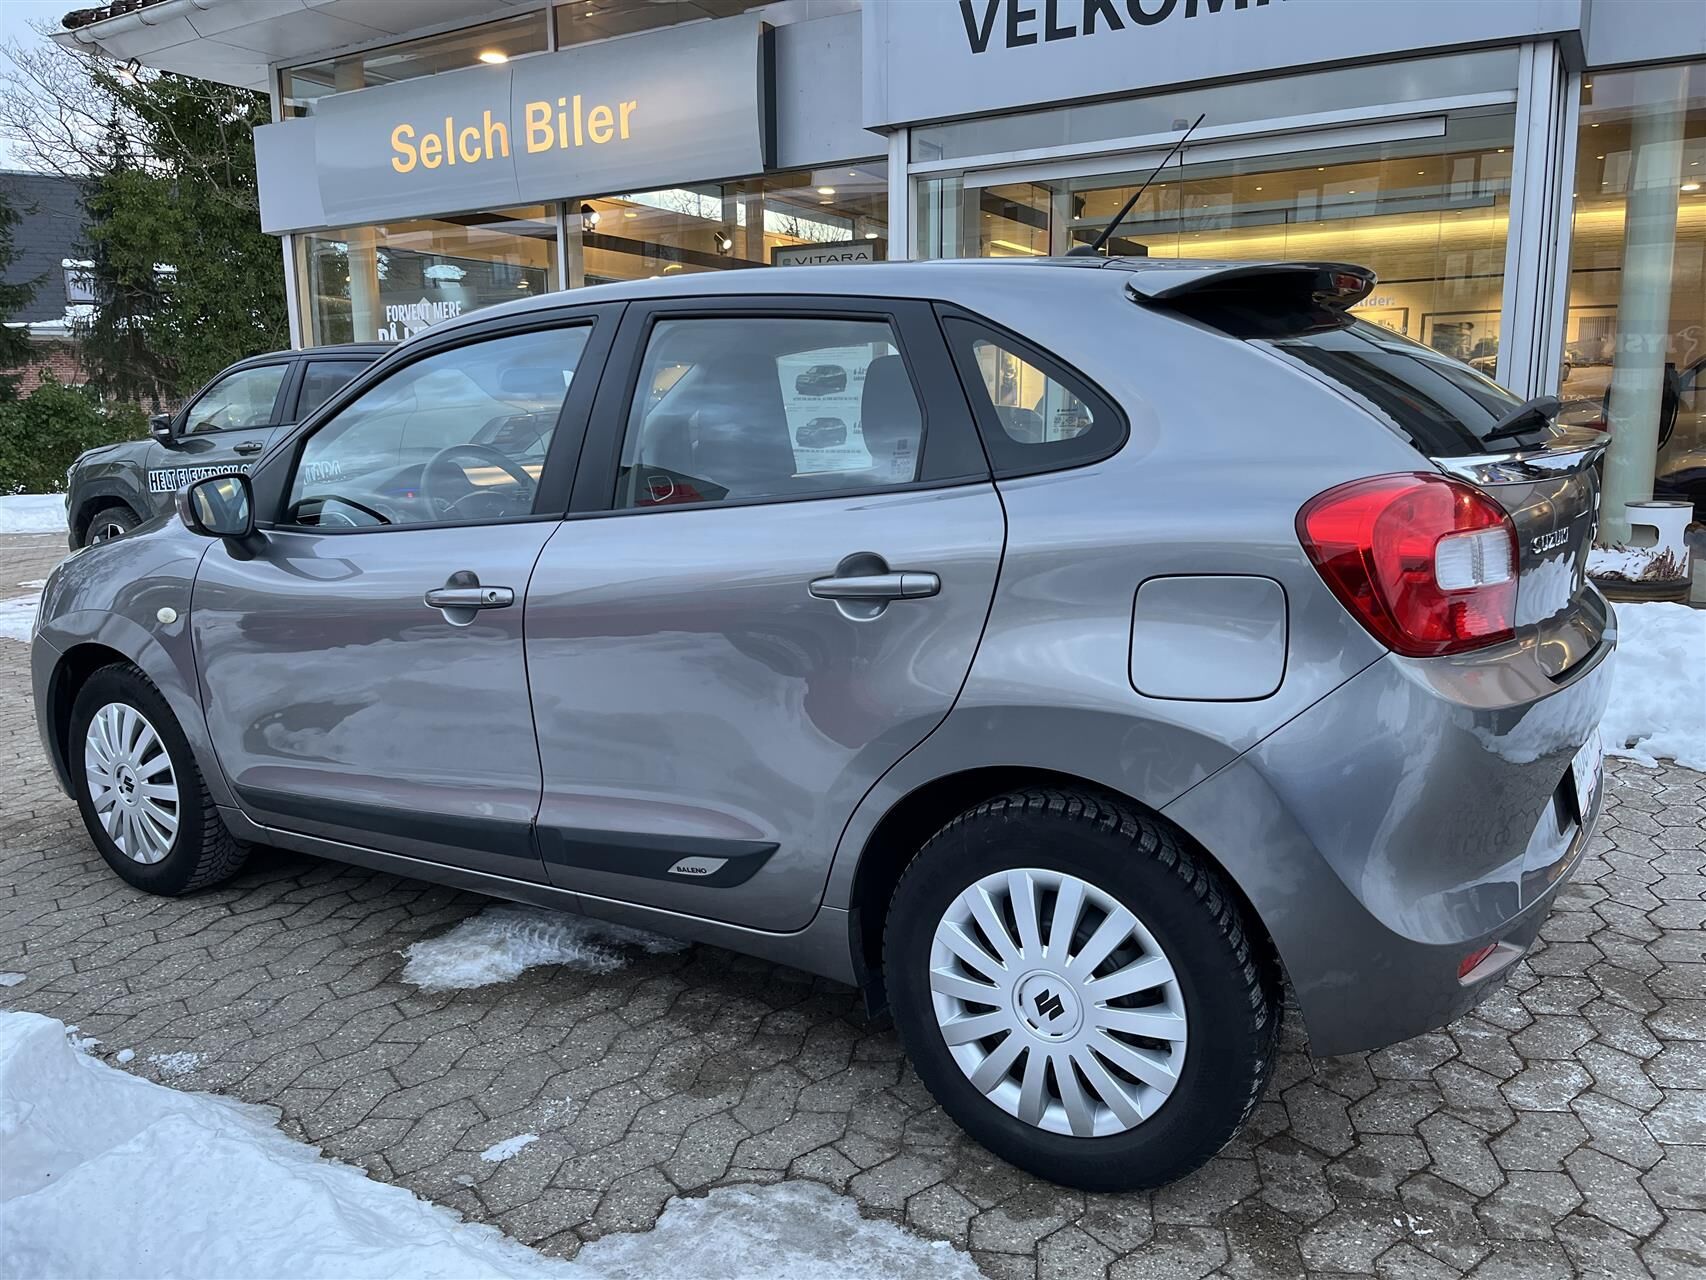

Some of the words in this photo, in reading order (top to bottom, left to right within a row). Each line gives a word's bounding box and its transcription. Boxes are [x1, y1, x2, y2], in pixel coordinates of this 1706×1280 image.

[391, 110, 510, 173] Selch
[525, 94, 637, 154] Biler
[794, 252, 870, 265] VITARA
[385, 303, 431, 322] FORVENT
[149, 470, 177, 492] HELT
[676, 866, 708, 874] BALENO
